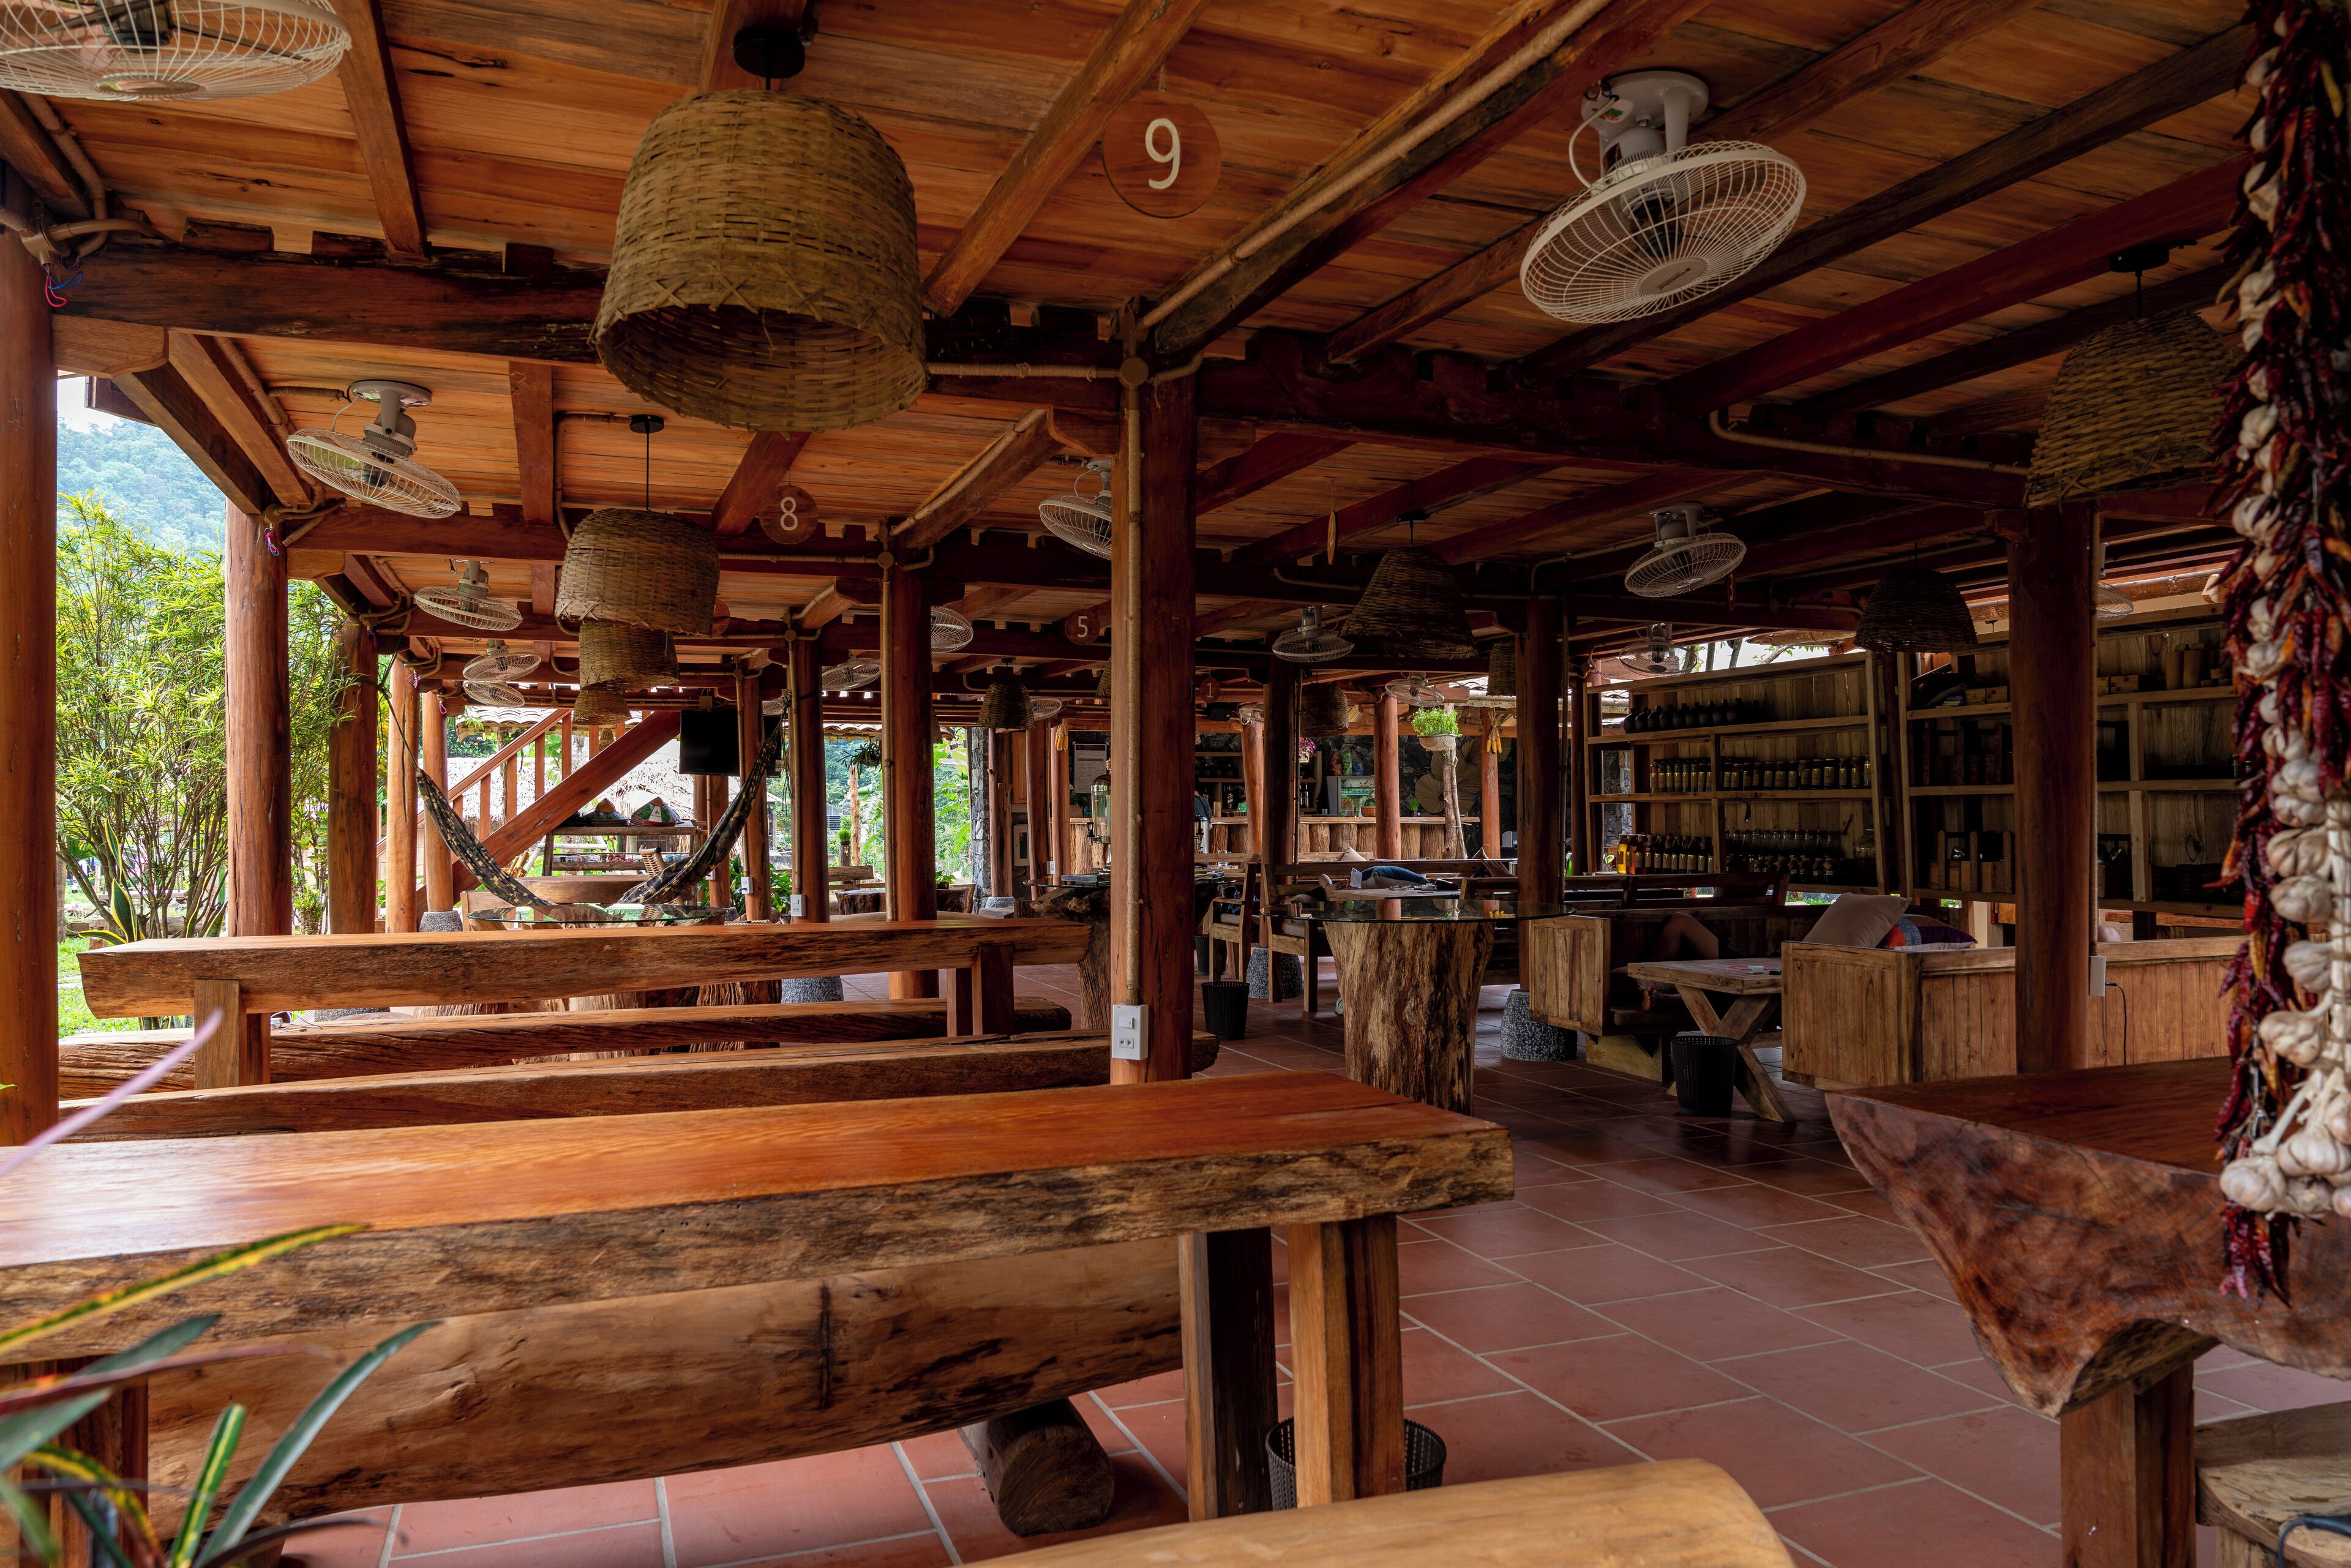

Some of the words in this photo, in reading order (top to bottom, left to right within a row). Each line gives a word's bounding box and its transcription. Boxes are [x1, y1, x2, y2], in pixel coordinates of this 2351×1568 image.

[1145, 118, 1181, 190] 9
[780, 497, 798, 531] 8
[1078, 615, 1088, 638] 5
[1207, 682, 1213, 698] 1
